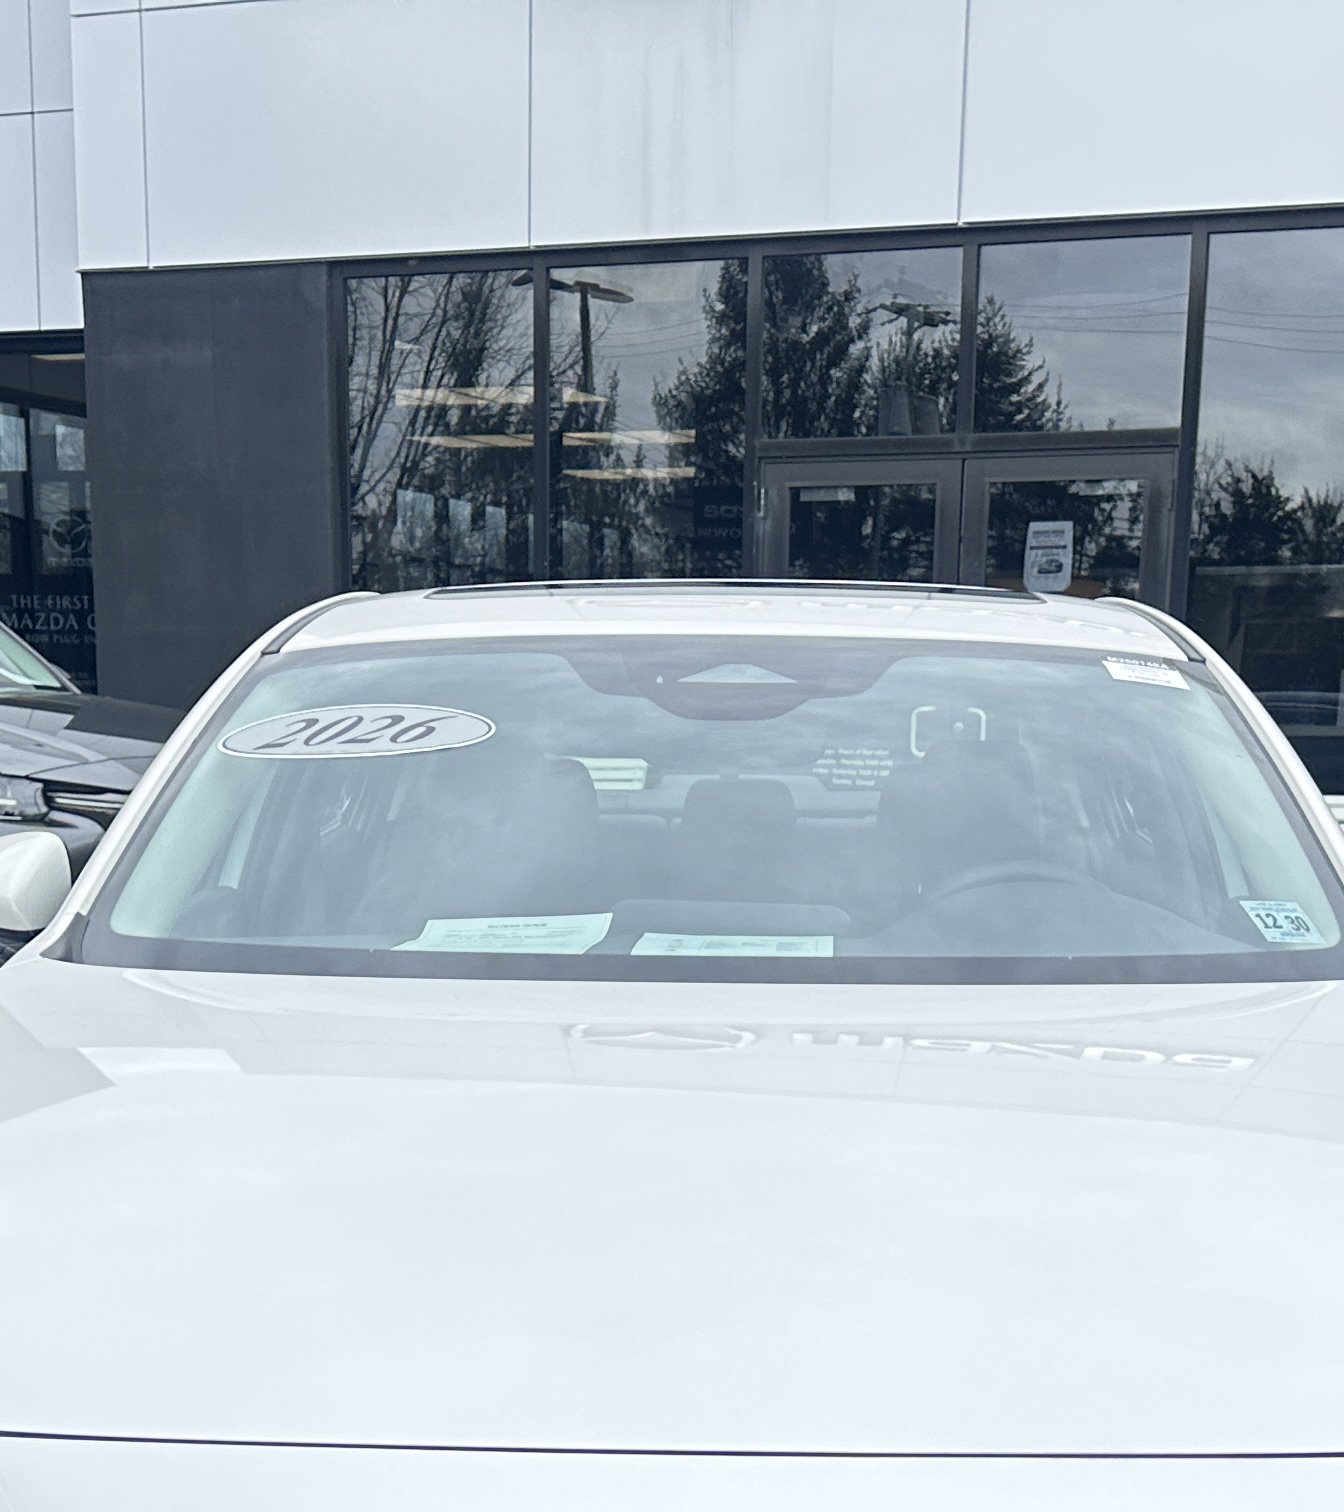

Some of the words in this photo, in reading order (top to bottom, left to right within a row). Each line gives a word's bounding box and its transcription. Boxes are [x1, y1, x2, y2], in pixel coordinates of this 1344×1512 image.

[10, 594, 41, 609] THE
[47, 594, 88, 609] FIRST
[1, 611, 79, 631] MAZDA
[252, 714, 457, 752] 2026
[1254, 912, 1284, 930] 12
[1284, 914, 1311, 933] 30
